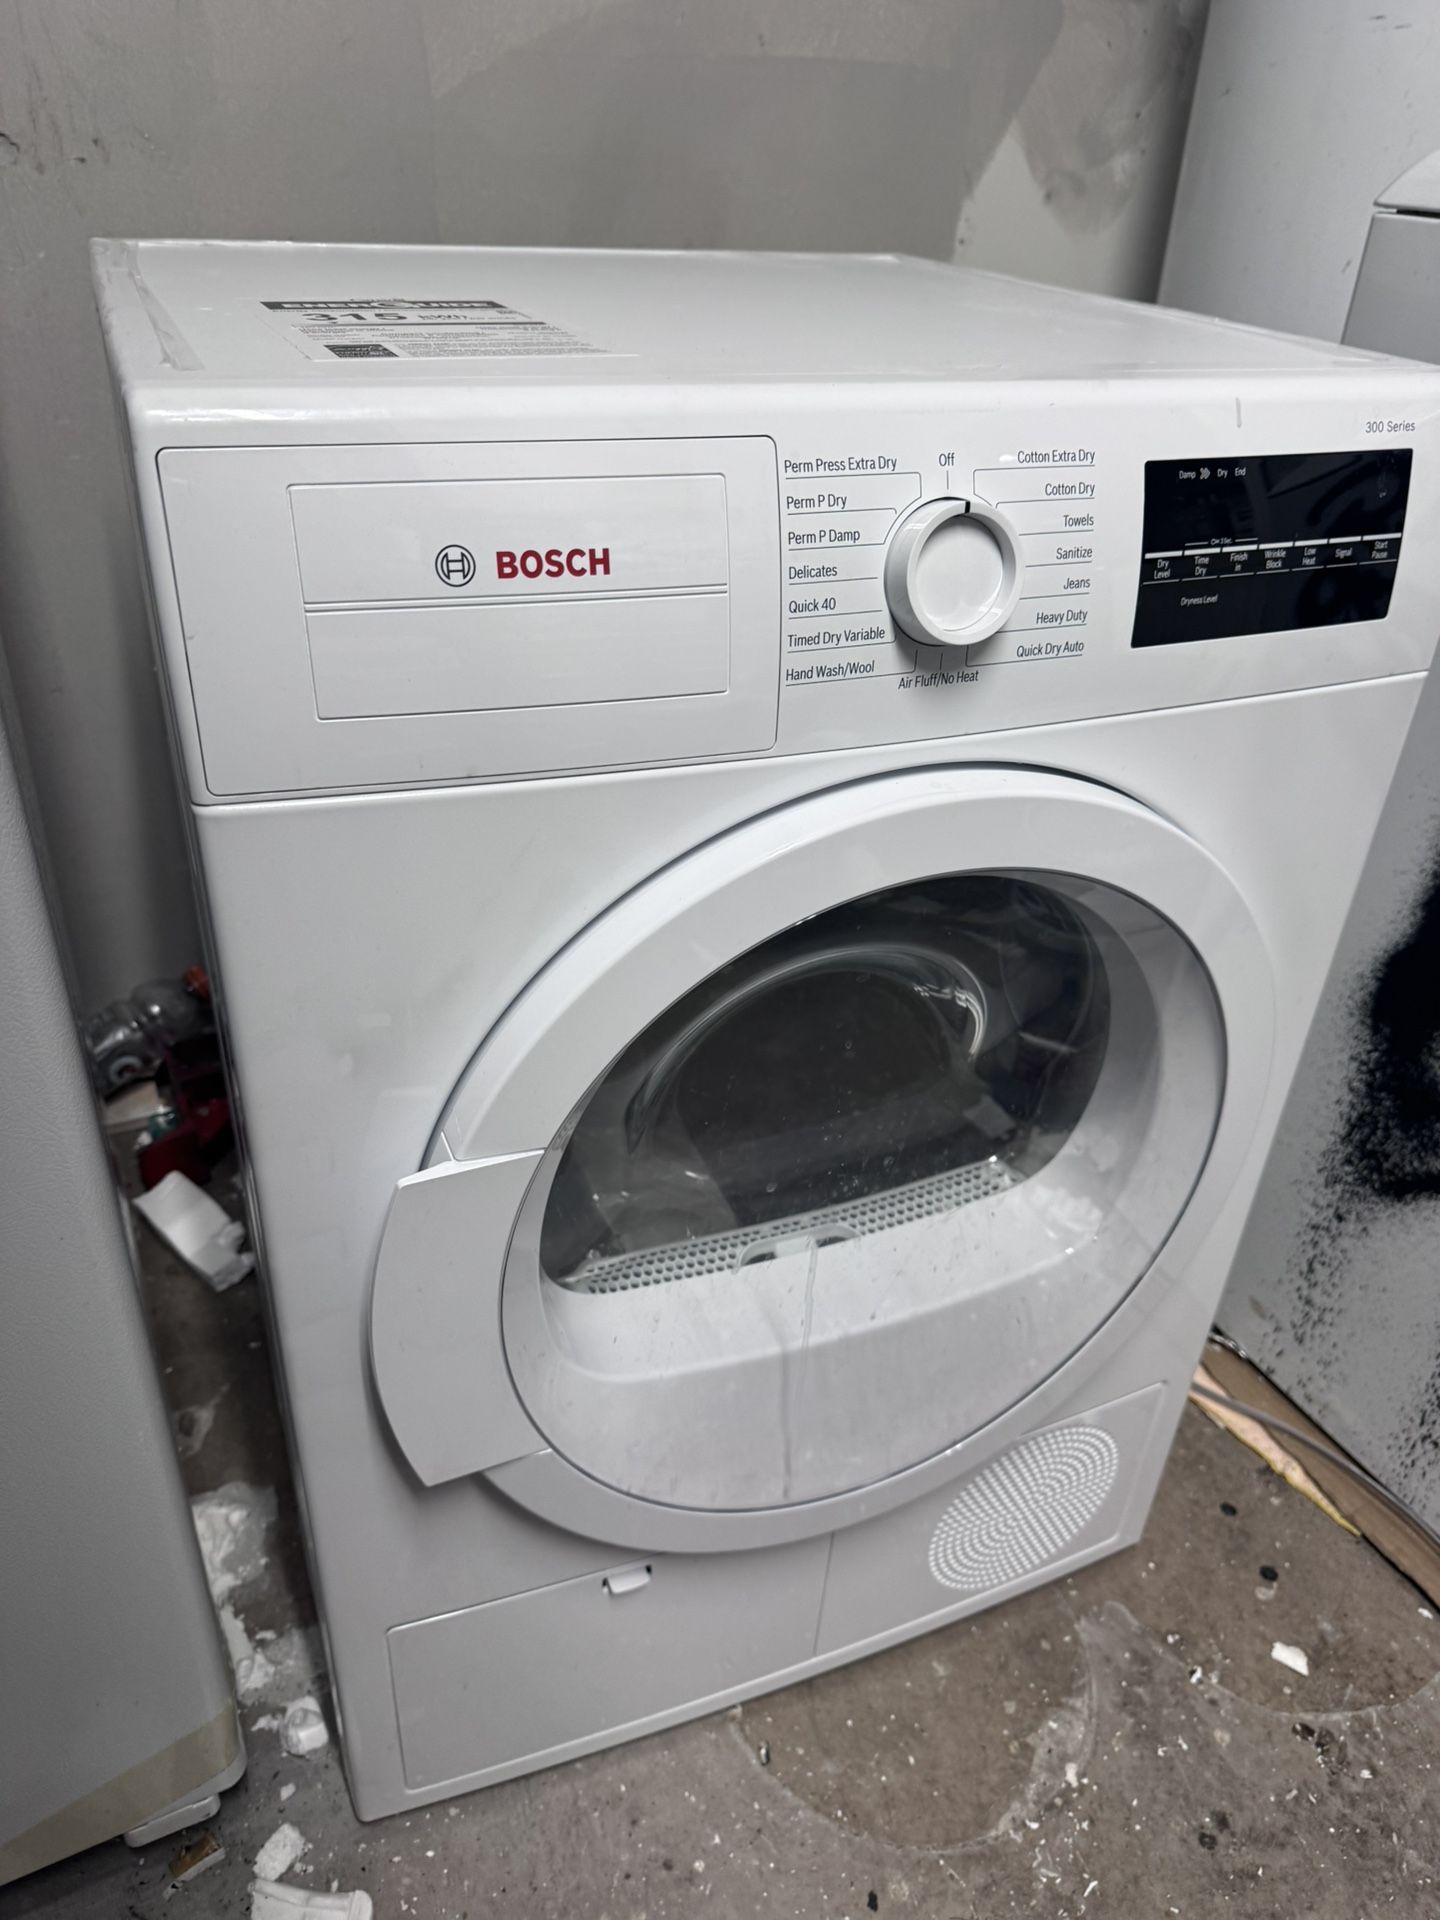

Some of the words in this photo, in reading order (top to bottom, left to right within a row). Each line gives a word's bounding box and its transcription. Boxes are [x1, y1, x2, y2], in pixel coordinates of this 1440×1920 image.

[302, 312, 408, 321] 315
[1365, 421, 1384, 433] 300
[1386, 420, 1416, 433] Series
[938, 452, 955, 467] Off
[1017, 450, 1050, 464] Cotton
[1052, 449, 1076, 463] Extra
[1078, 449, 1096, 464] Dry
[784, 459, 813, 473] Perm
[816, 458, 846, 472] Press
[848, 457, 876, 471] Extra
[878, 455, 897, 472] Dry
[1179, 470, 1196, 480] Damp
[1217, 469, 1228, 478] Dry
[1234, 467, 1246, 477] End
[1045, 483, 1076, 496] Cotton
[1078, 482, 1095, 496] Dry
[786, 496, 815, 509] Perm
[818, 494, 825, 505] P
[828, 493, 847, 509] Dry
[1063, 513, 1094, 527] Towels
[788, 531, 816, 545] Perm
[819, 530, 826, 543] P
[829, 529, 860, 543] Damp
[1056, 546, 1092, 560] Sanitize
[1230, 552, 1248, 562] Finish
[1264, 549, 1287, 559] Wrinkle
[1335, 548, 1353, 559] Signal
[496, 548, 611, 579] BOSCH
[1157, 560, 1169, 570] Dry
[1194, 556, 1210, 565] Time
[788, 565, 838, 580] Delicates
[1154, 569, 1171, 579] Level
[1195, 566, 1207, 576] Dry
[1064, 577, 1091, 590] Jeans
[788, 598, 819, 614] Quick
[821, 597, 836, 610] 40
[1181, 596, 1202, 607] Dryness
[1203, 594, 1219, 604] Level
[1036, 611, 1064, 625] Heavy
[1066, 609, 1088, 623] Duty
[788, 632, 820, 647] Timed
[822, 630, 841, 646] Dry
[844, 626, 885, 642] Variable
[1016, 643, 1043, 657] Quick
[1045, 642, 1062, 656] Dry
[1063, 641, 1084, 653] Auto
[785, 665, 813, 681] Hand
[816, 660, 875, 678] Wash/Wool
[898, 677, 912, 689] Air
[915, 671, 955, 688] Fluff/No
[957, 671, 979, 683] Heat
